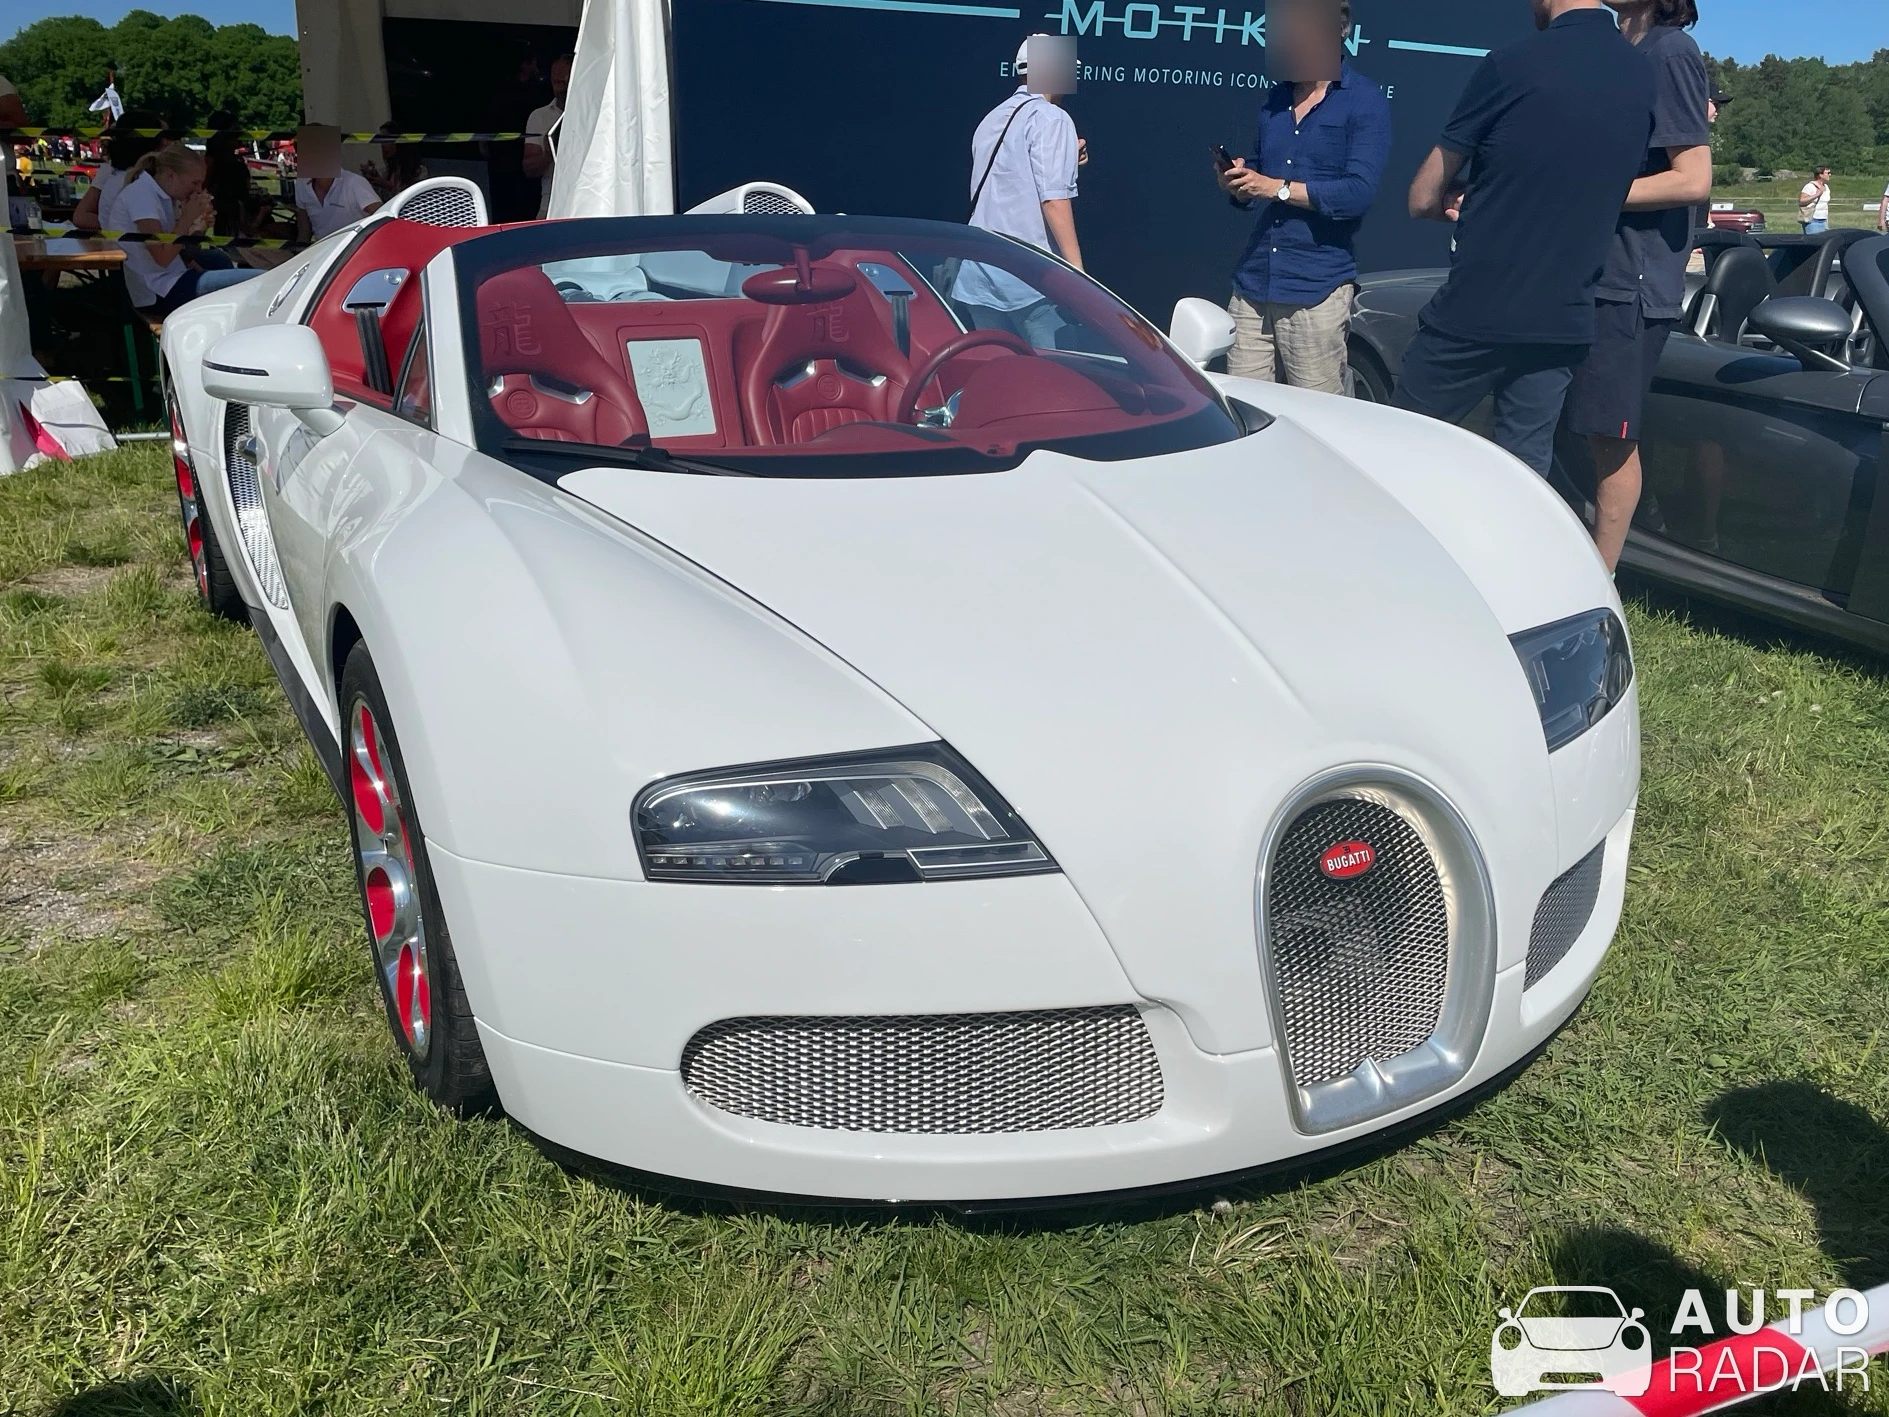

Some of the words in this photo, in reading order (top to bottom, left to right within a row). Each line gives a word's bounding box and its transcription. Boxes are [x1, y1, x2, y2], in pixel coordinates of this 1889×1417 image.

[1059, 0, 1362, 57] MOTIKN
[1133, 67, 1223, 87] MOTORING
[1230, 72, 1278, 90] ICON
[1327, 850, 1371, 871] BUGATTI
